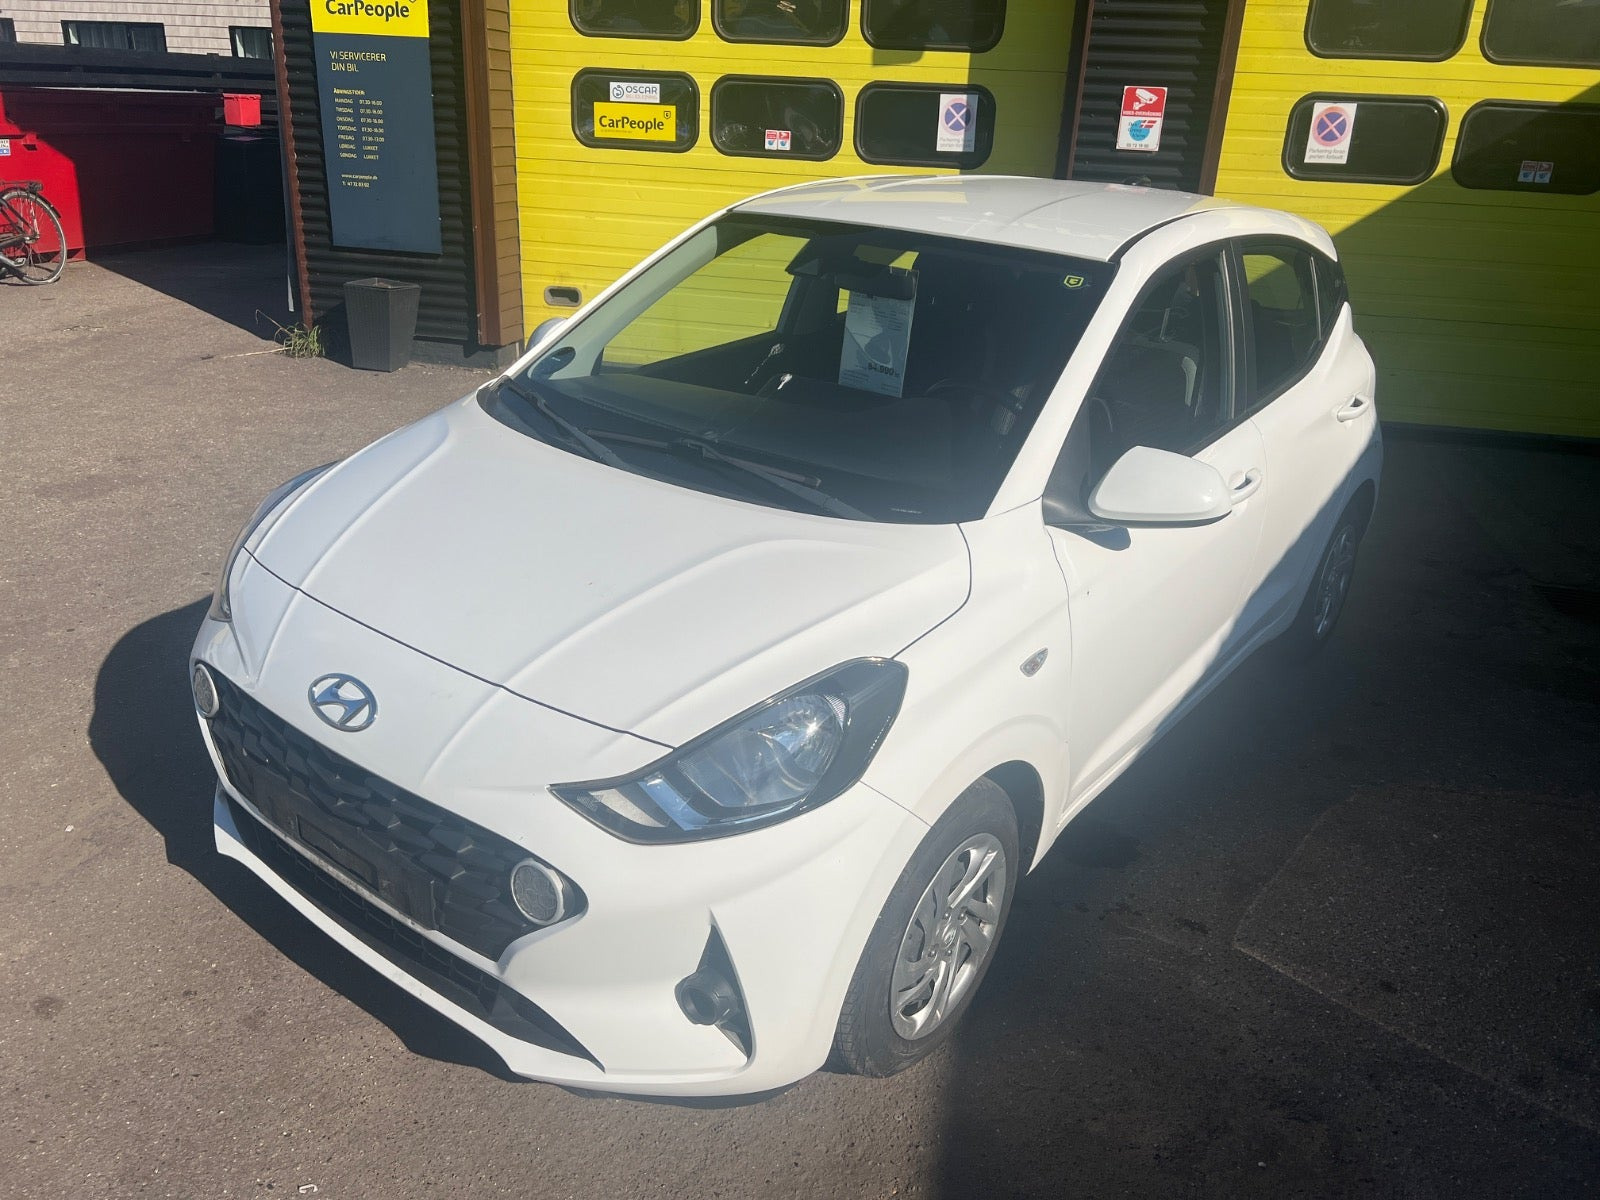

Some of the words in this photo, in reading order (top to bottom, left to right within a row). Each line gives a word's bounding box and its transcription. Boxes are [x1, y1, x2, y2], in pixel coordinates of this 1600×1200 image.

[325, 0, 410, 22] CarPeople
[329, 50, 338, 60] VI
[339, 51, 387, 62] SERVICERER
[331, 62, 345, 72] DIN
[346, 62, 359, 73] BIL
[625, 85, 658, 95] OSCAR
[599, 115, 664, 133] CarPeople
